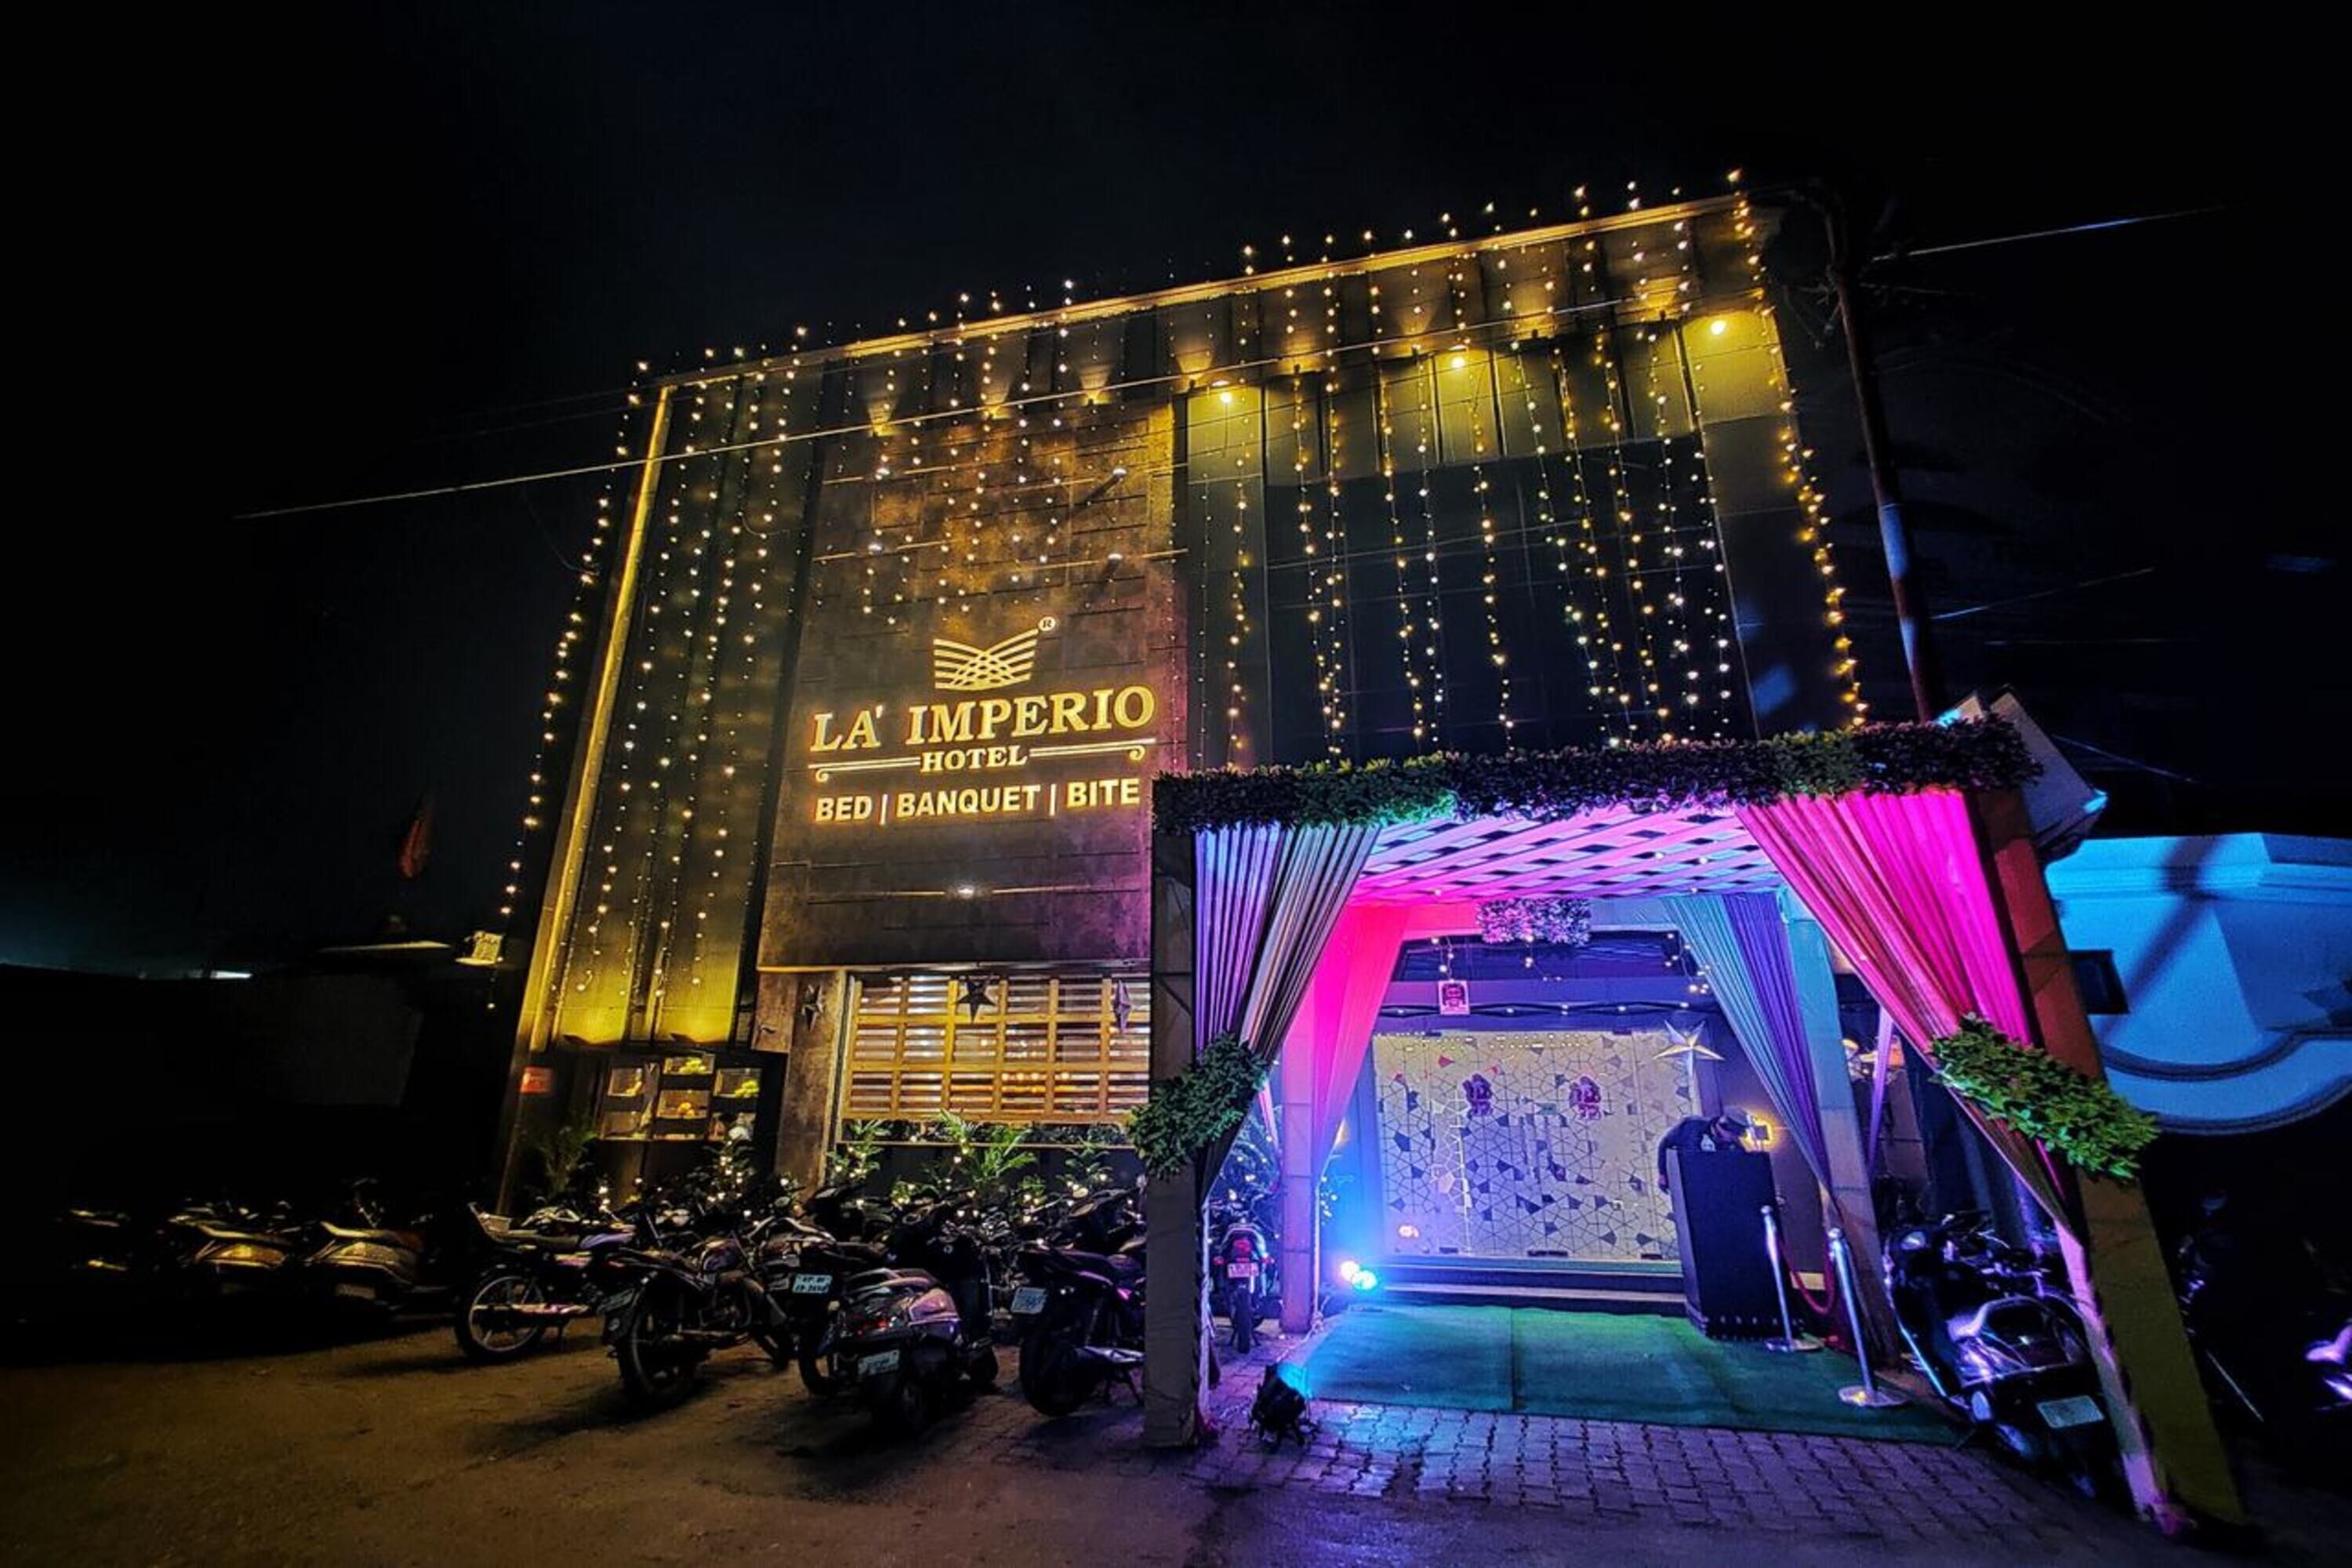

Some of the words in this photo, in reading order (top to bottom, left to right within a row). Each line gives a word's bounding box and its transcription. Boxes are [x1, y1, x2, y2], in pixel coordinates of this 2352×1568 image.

[906, 686, 1155, 745] IMPERIO
[920, 746, 1028, 773] HOTEL
[815, 796, 873, 822] BED
[895, 785, 1040, 818] BANQUET
[1067, 778, 1140, 808] BITE
